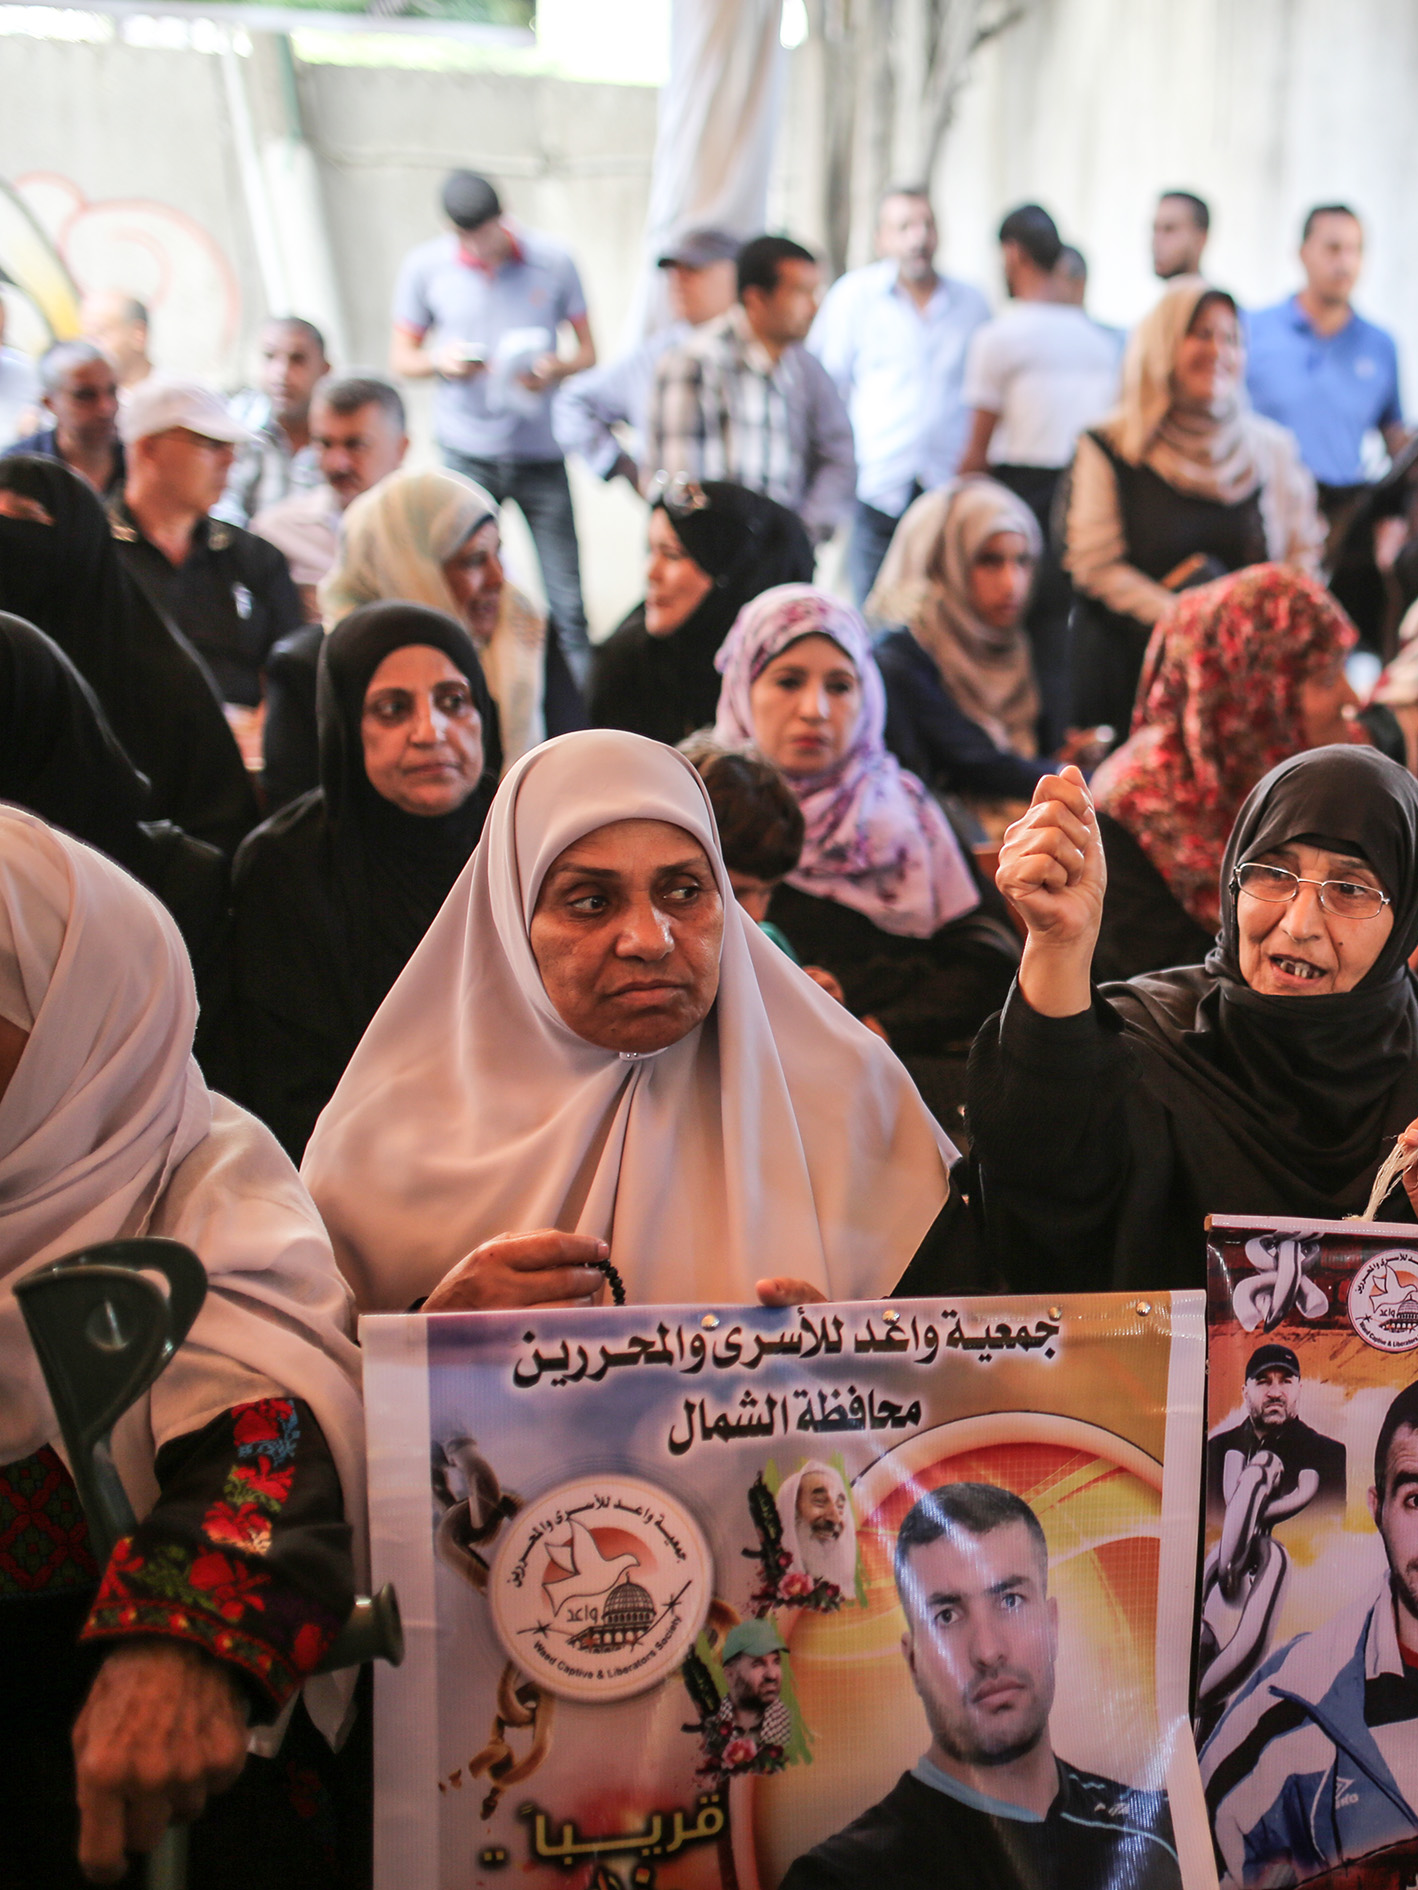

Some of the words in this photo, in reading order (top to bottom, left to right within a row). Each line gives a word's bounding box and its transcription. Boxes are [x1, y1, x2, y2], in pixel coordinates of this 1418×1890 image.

[712, 1306, 844, 1370] للأسرى
[941, 1309, 1060, 1360] جمعية
[1380, 1308, 1396, 1318] واعد
[513, 1321, 707, 1389] والمحررين
[854, 1315, 940, 1364] واعد
[668, 1389, 789, 1456] الشمال
[793, 1385, 922, 1433] محافظة
[613, 1498, 654, 1525] واعد
[654, 1513, 687, 1564] جمعية
[566, 1604, 598, 1622] واعد
[533, 1640, 558, 1666] Waed
[557, 1660, 594, 1680] Captive
[597, 1669, 605, 1680] &
[607, 1648, 657, 1680] Liberators
[655, 1615, 683, 1652] Society
